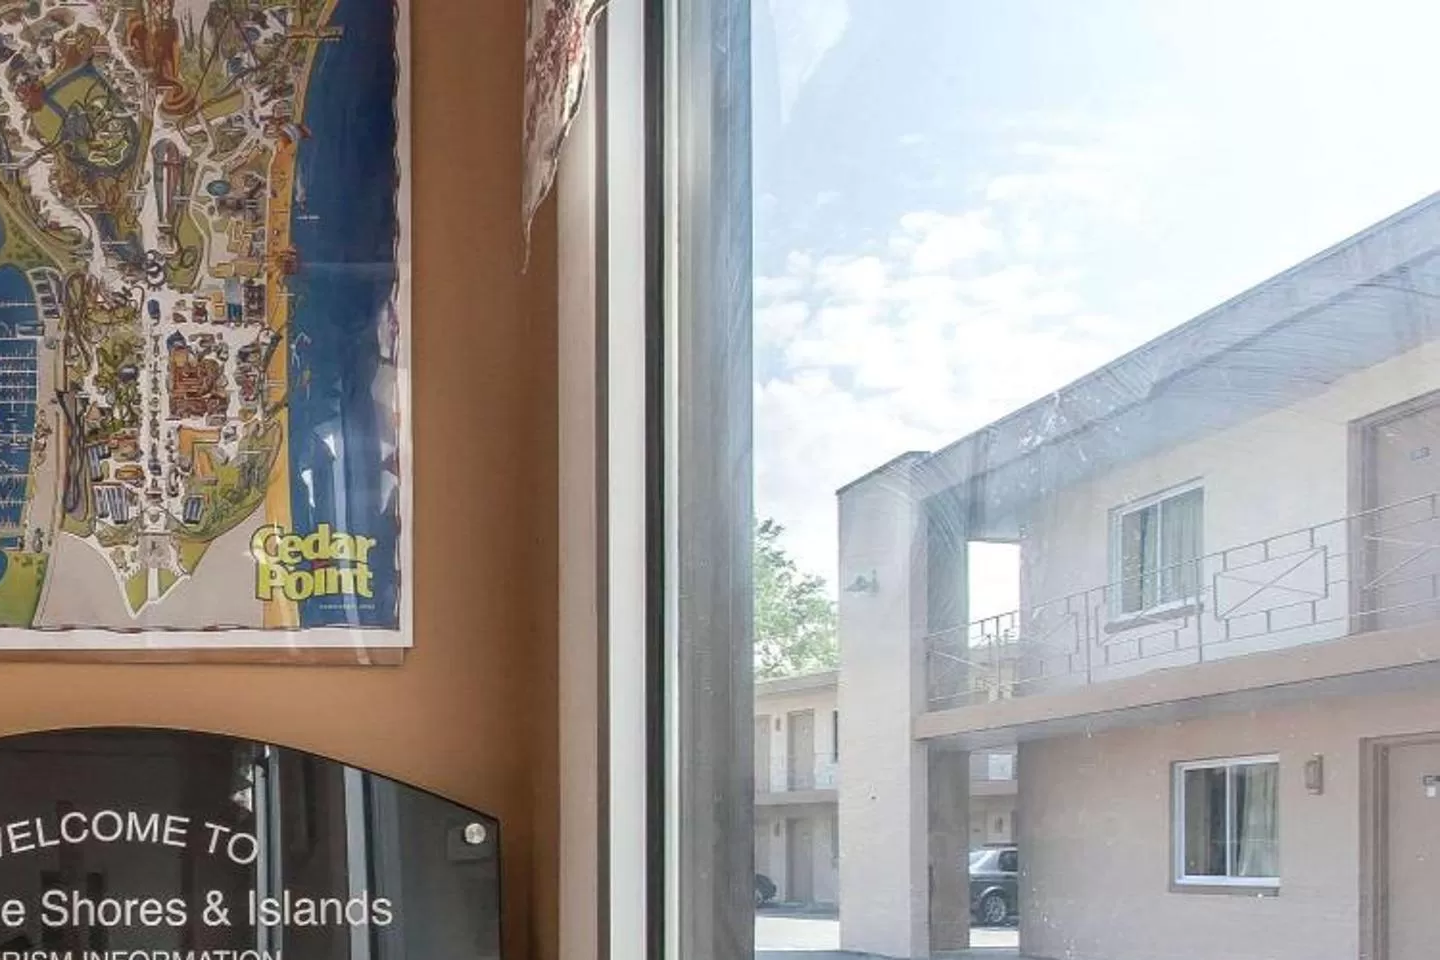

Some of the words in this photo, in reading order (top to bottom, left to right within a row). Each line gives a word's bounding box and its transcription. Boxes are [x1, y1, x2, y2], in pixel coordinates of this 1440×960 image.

[250, 522, 377, 566] Cedar
[256, 561, 373, 600] Point
[205, 823, 259, 866] TO
[40, 890, 188, 929] Shores
[202, 891, 232, 929] &
[249, 891, 394, 929] Islands
